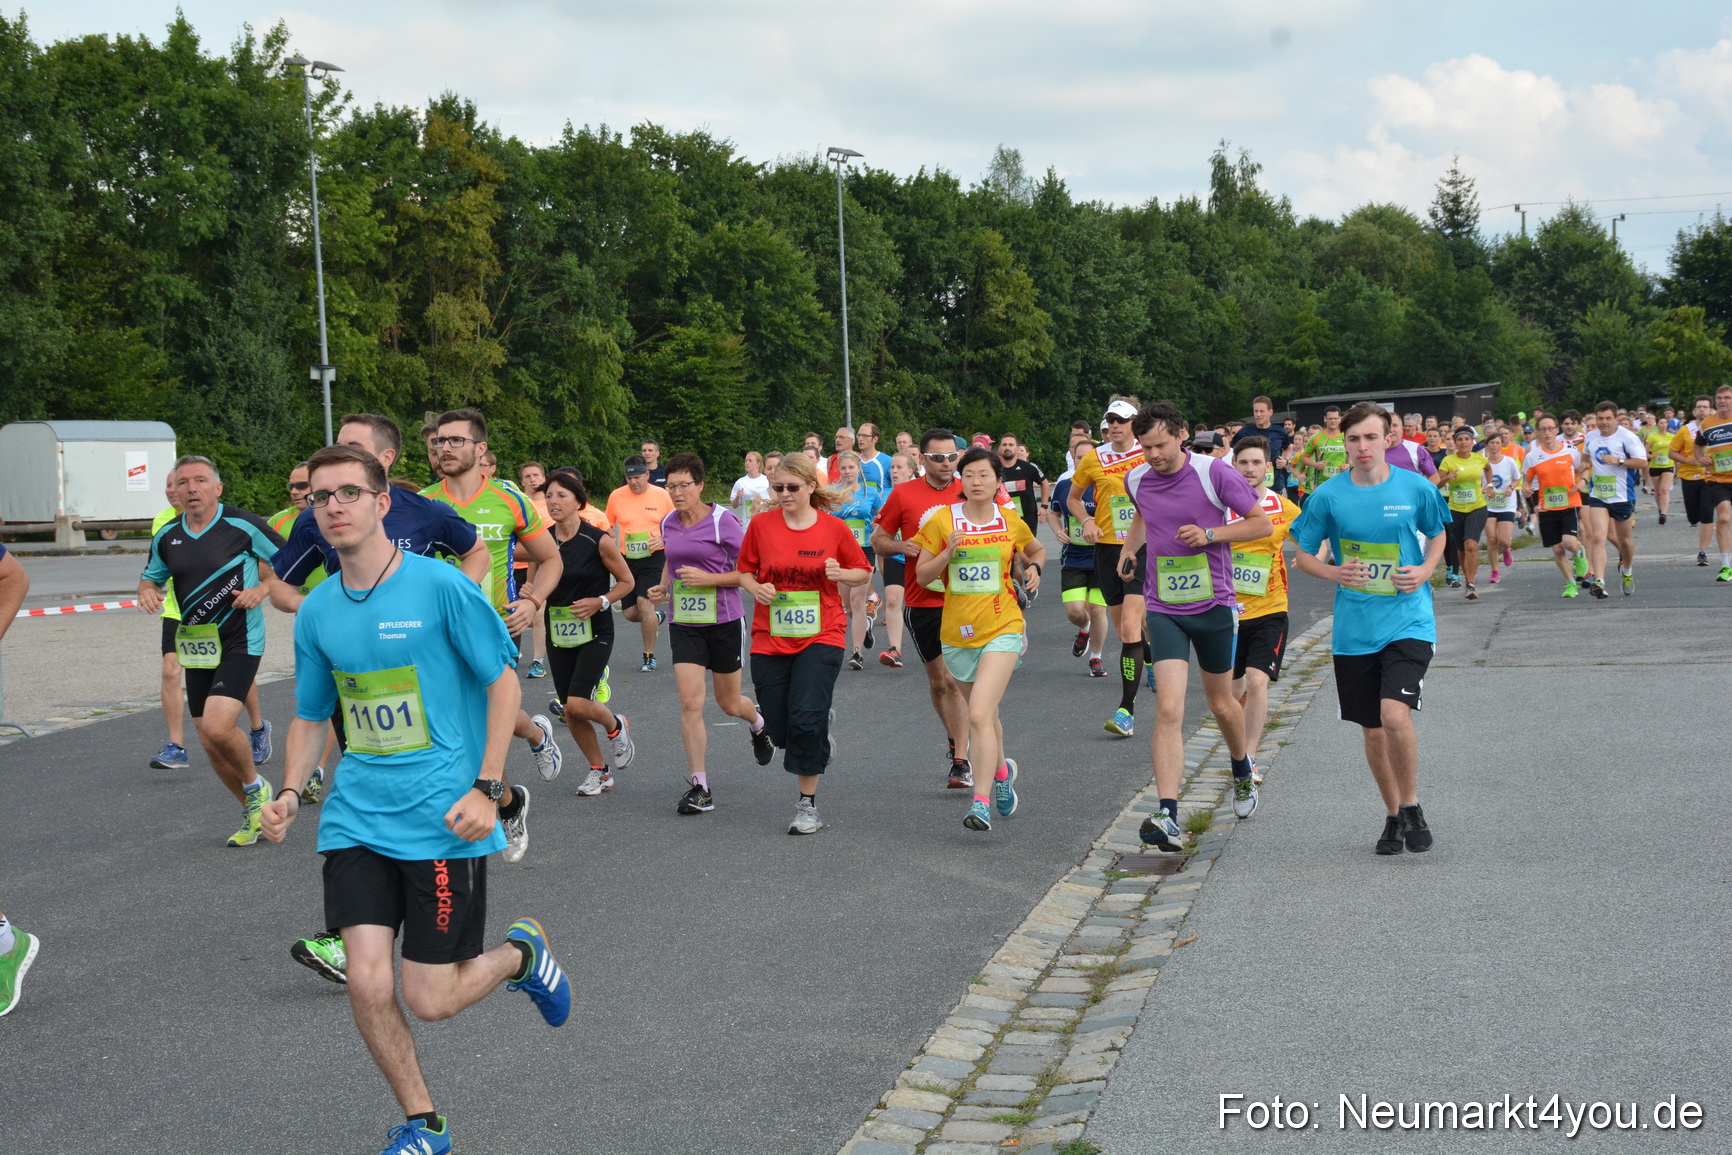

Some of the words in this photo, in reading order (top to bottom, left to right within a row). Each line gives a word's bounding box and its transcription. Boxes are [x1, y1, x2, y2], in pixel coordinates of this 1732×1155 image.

[1103, 465, 1129, 476] MAX
[1457, 490, 1472, 499] 596
[1548, 494, 1564, 503] 490
[983, 534, 1012, 544] BÖGL
[626, 542, 648, 552] 1570
[958, 565, 991, 582] 828
[1233, 566, 1261, 583] 869
[1167, 574, 1201, 590] 322
[204, 574, 240, 610] Donauer
[680, 597, 707, 611] 325
[775, 609, 816, 625] 1485
[379, 632, 407, 640] Thomas
[553, 621, 586, 637] 1221
[179, 641, 218, 656] 1353
[349, 700, 413, 732] 1101
